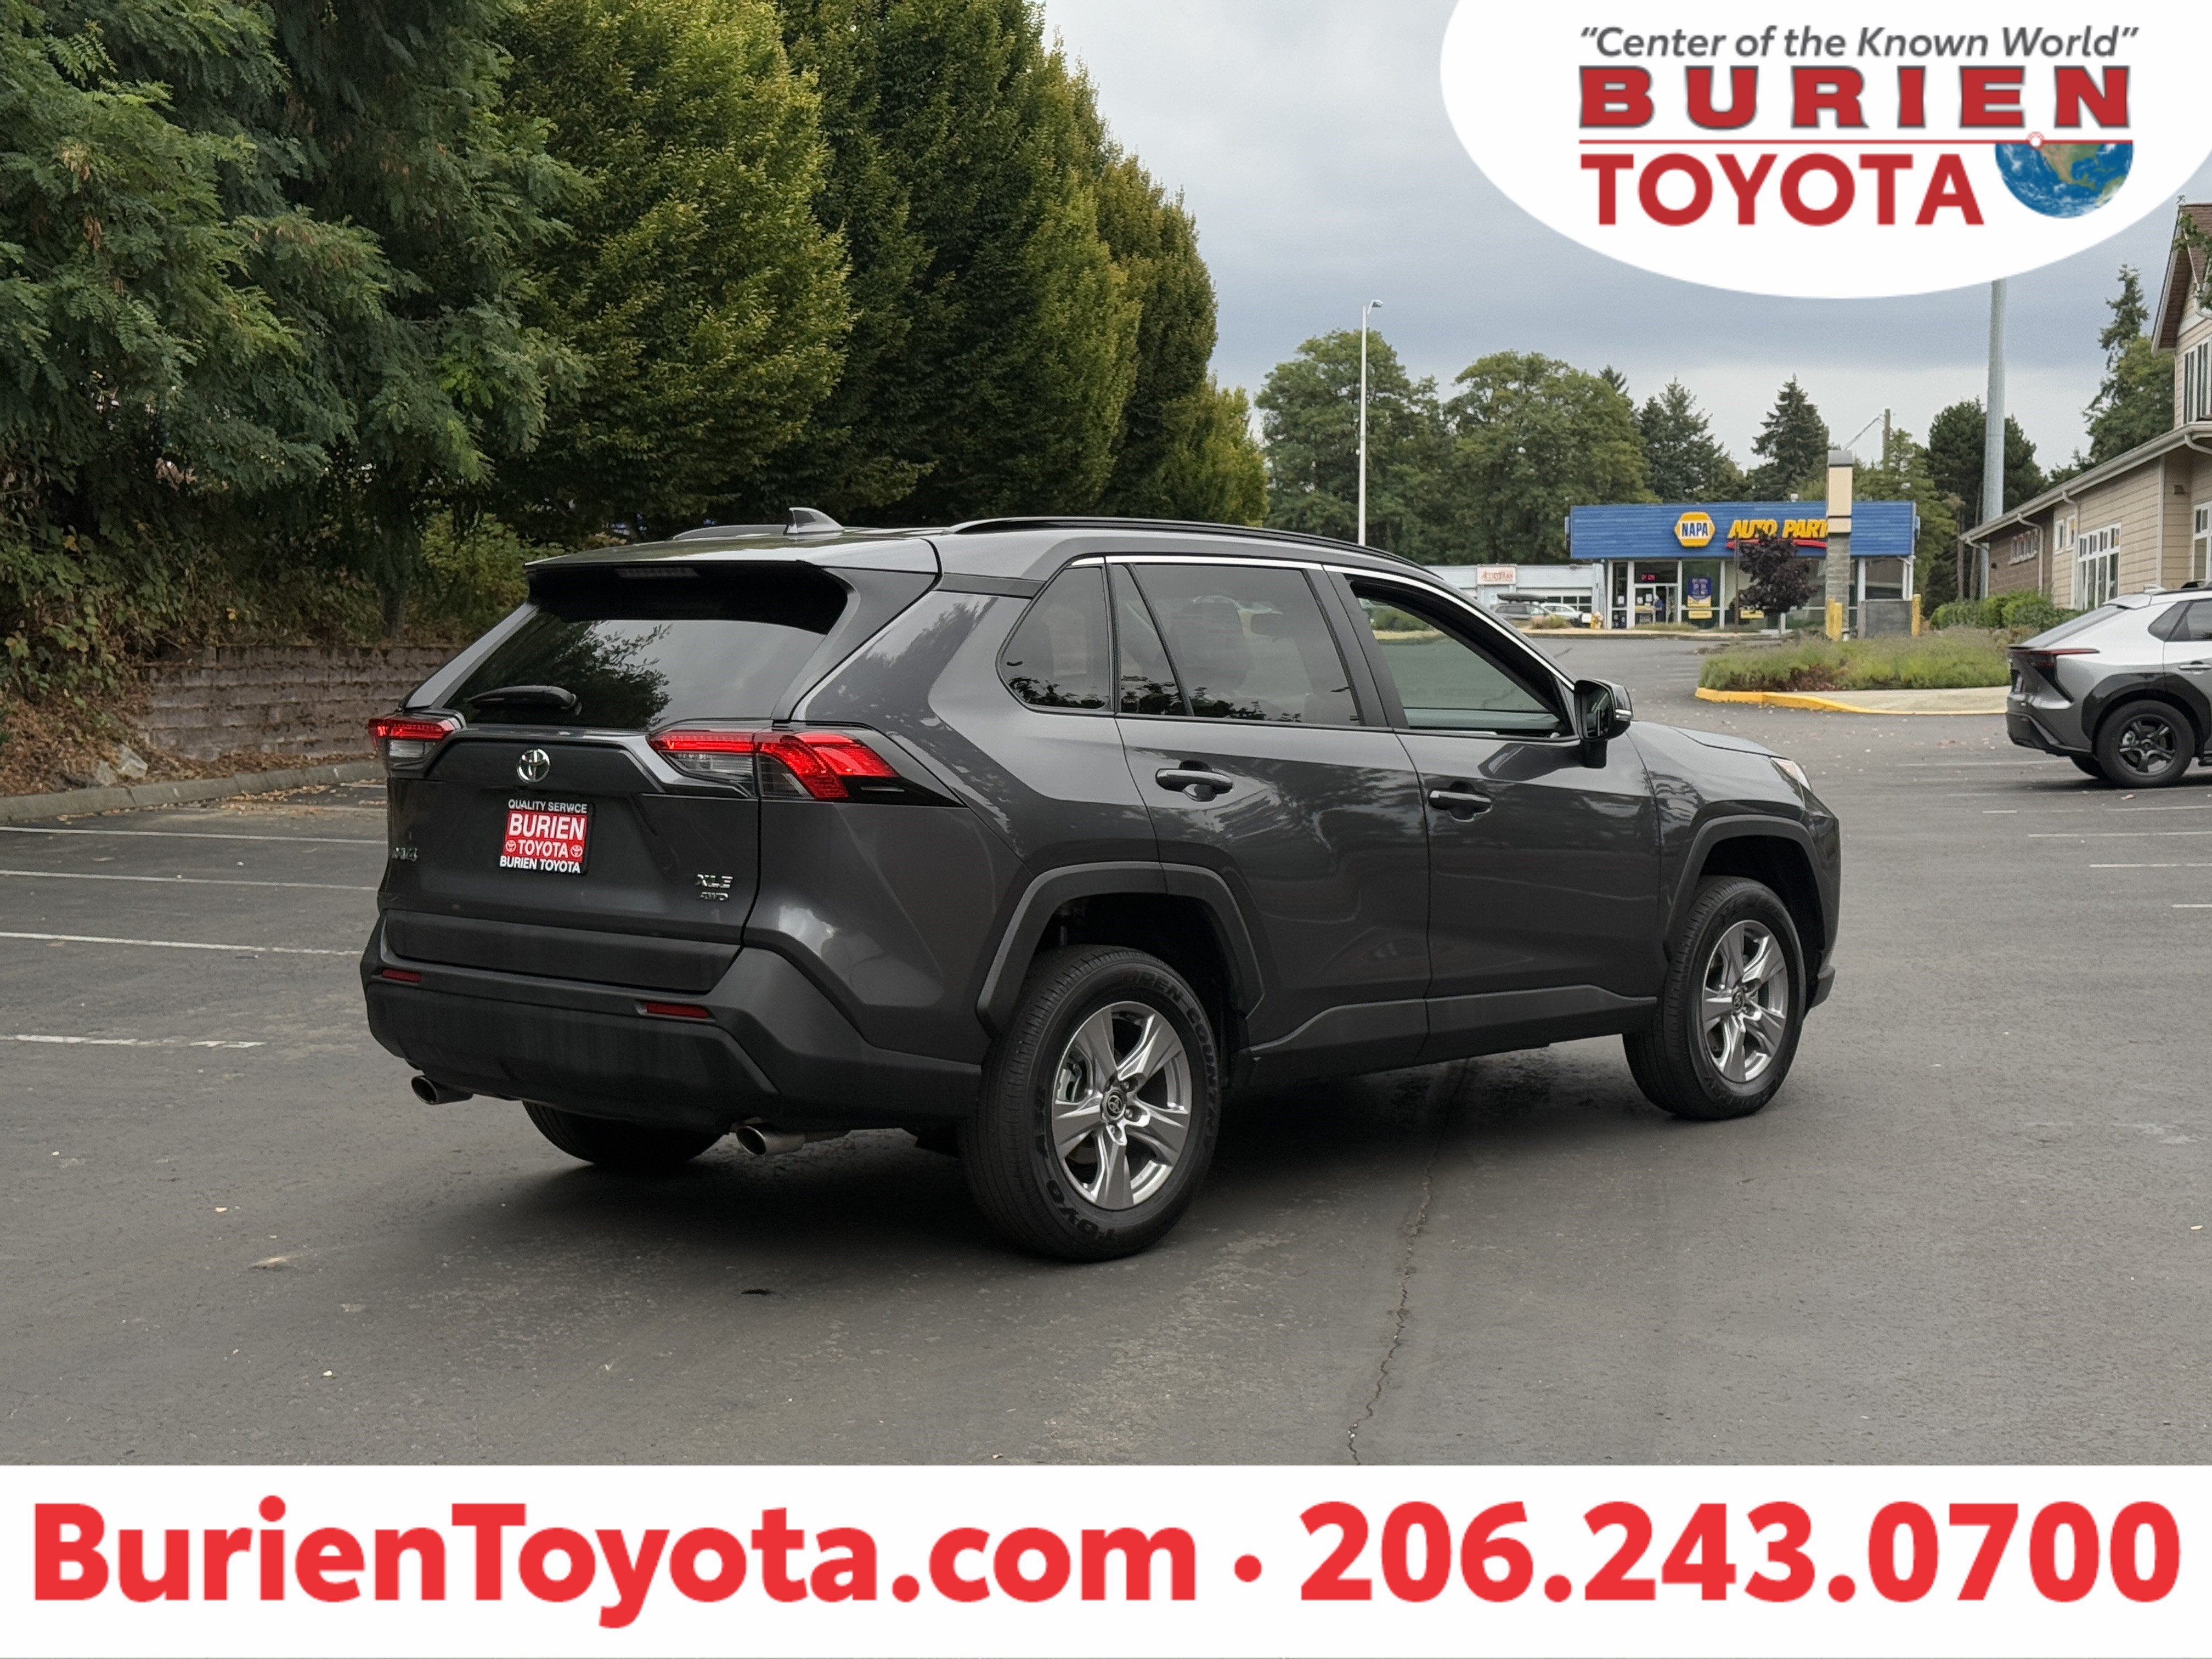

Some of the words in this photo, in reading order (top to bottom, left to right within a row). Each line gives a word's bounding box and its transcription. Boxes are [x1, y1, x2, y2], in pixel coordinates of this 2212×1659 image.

[1681, 522, 1708, 537] NAPA
[1727, 518, 1778, 539] AUTO
[1782, 518, 1829, 539] PART
[508, 799, 546, 811] QUALITY
[548, 802, 588, 814] SERVICE
[509, 813, 585, 840] BURIEN
[518, 839, 569, 859] TOYOTA
[500, 855, 537, 870] BURIEN
[539, 859, 581, 874] TOYOTA
[695, 873, 733, 888] XLE
